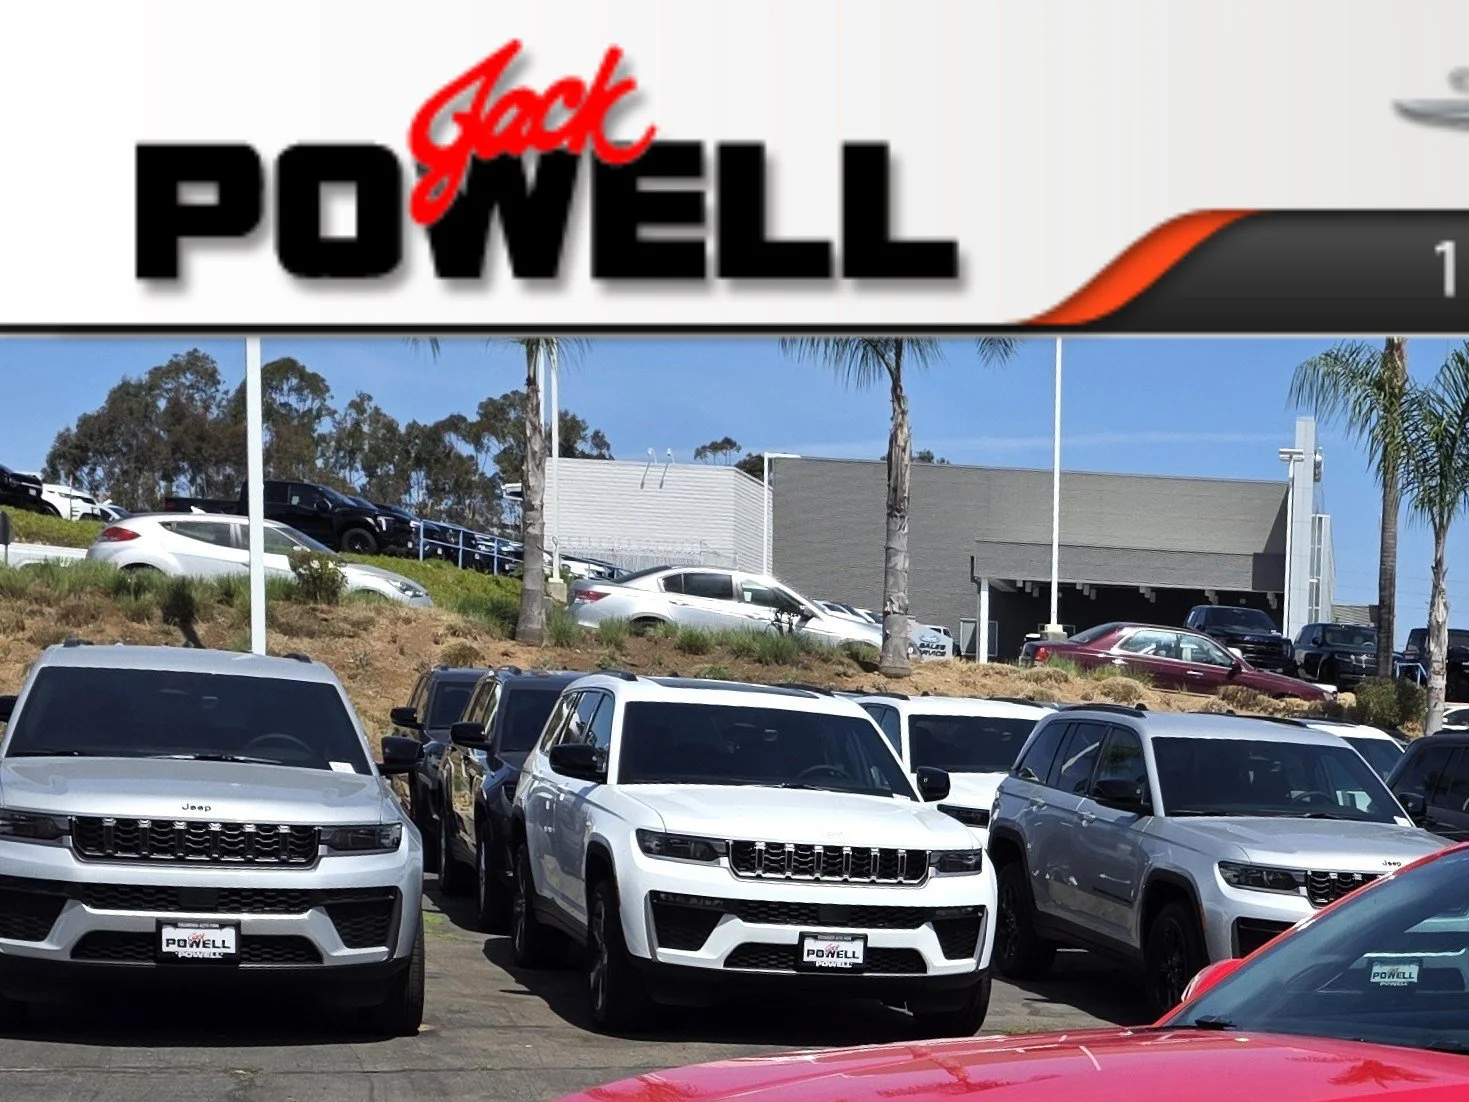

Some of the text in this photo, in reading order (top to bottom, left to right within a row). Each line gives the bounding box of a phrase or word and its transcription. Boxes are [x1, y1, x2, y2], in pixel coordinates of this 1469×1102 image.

[181, 803, 212, 813] Jeep
[165, 938, 231, 949] POWELL
[806, 948, 860, 959] POWELL
